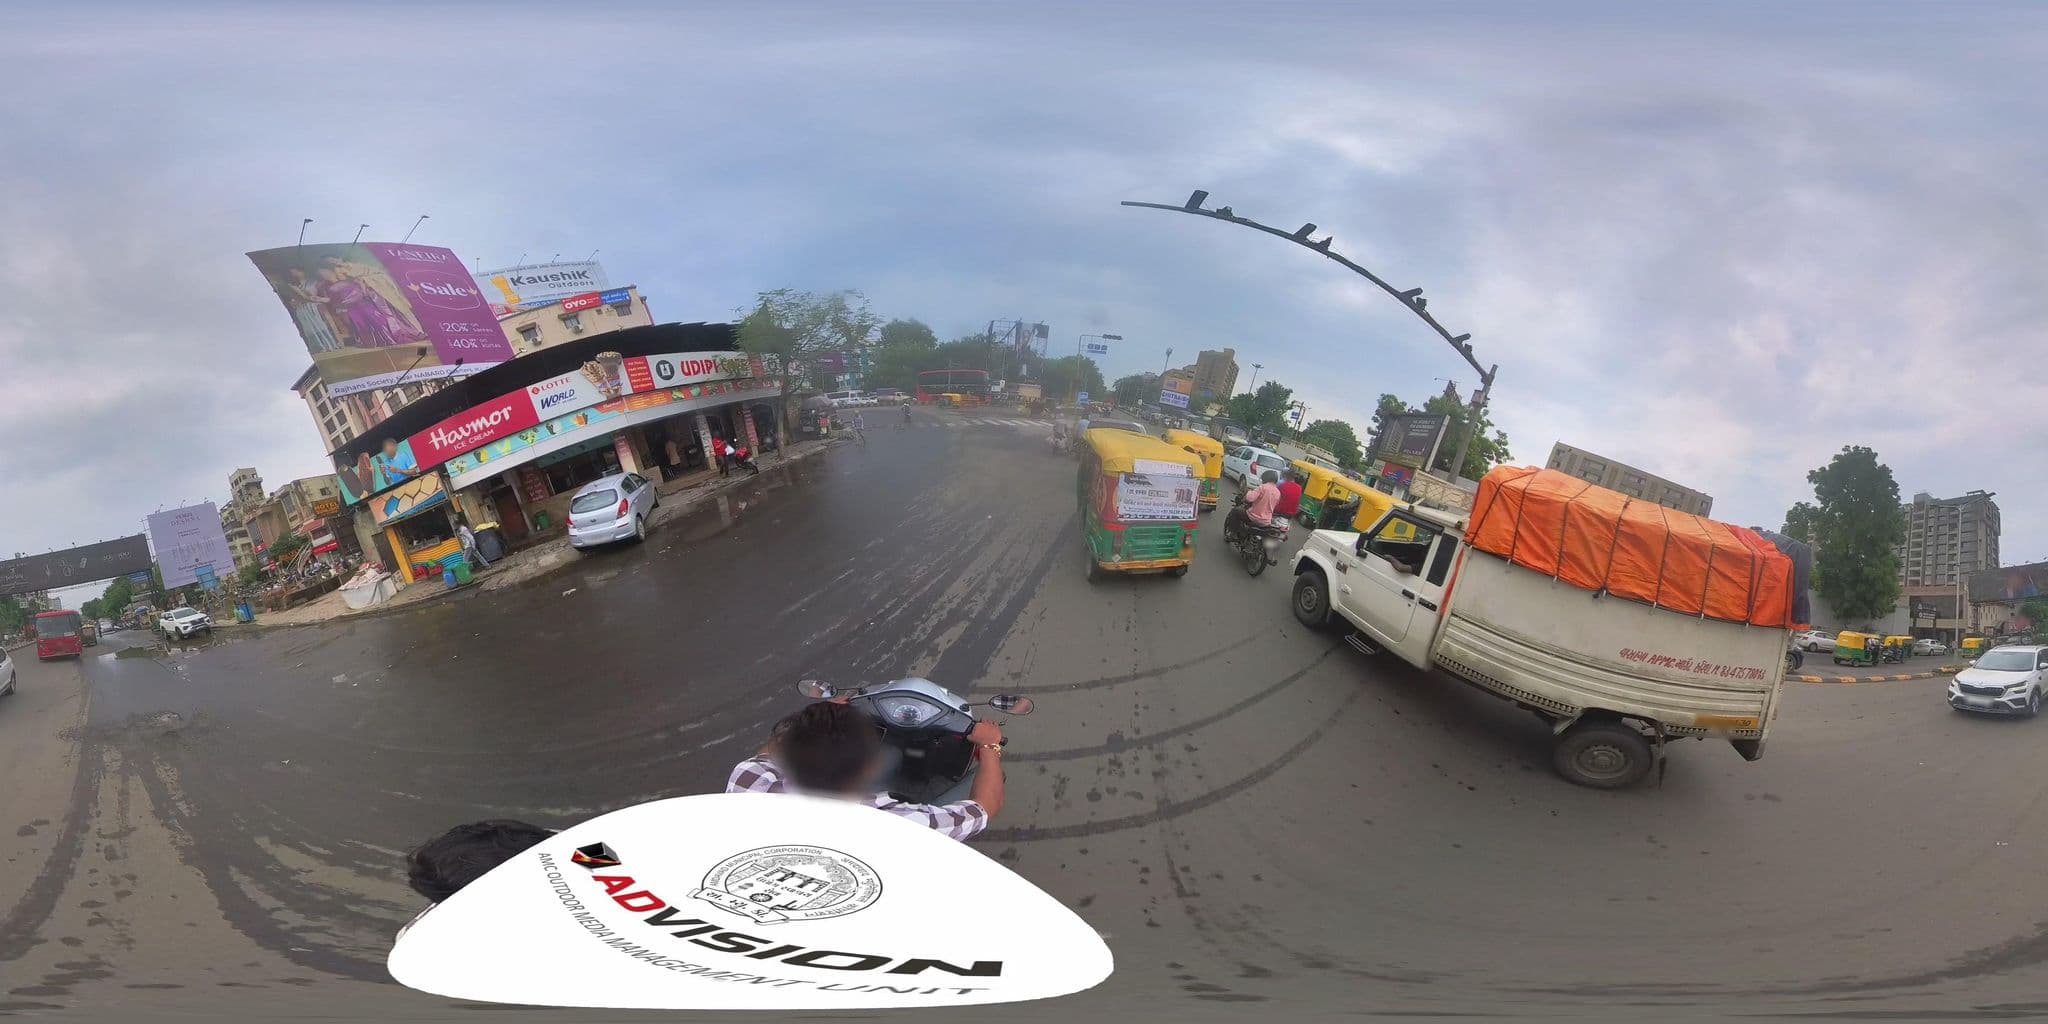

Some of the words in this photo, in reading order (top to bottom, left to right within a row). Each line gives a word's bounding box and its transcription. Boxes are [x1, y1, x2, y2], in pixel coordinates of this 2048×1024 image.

[420, 282, 468, 297] Sale
[548, 280, 595, 289] Outdoors
[564, 299, 587, 309] OYO
[680, 359, 719, 377] UDIPI
[334, 382, 366, 395] Rajhans
[541, 377, 571, 391] LOTTE
[540, 388, 576, 410] WORLD
[428, 405, 513, 450] Havmor
[454, 442, 468, 451] ICE
[468, 429, 495, 445] CREAM
